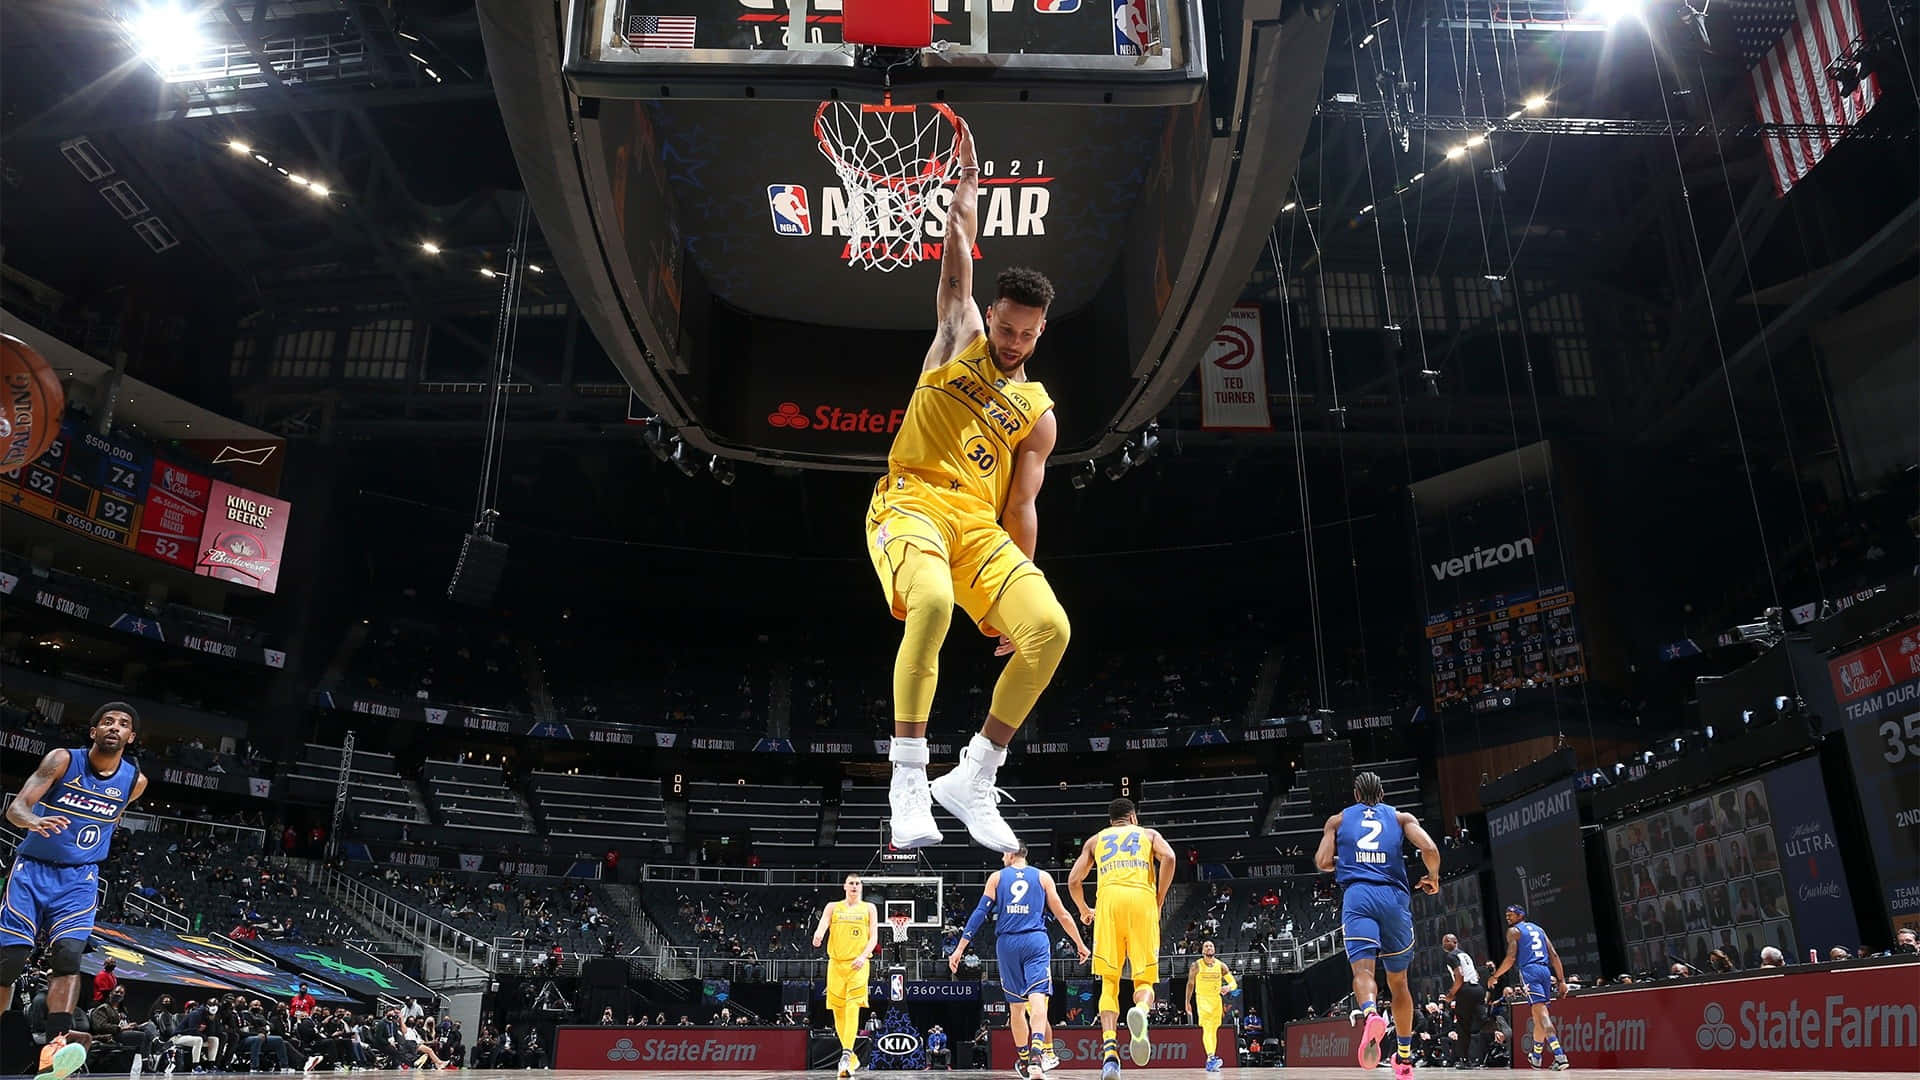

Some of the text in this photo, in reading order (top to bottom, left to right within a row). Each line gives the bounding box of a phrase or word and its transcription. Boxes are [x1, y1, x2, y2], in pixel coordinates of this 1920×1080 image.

[1120, 44, 1136, 55] NBA
[958, 160, 1044, 176] 021
[780, 223, 797, 233] NBA
[840, 243, 983, 260] ATLANA
[1224, 377, 1243, 389] TED
[1013, 394, 1028, 410] KIA
[1215, 392, 1255, 404] TURNER
[813, 405, 906, 434] StateF
[85, 434, 133, 462] $500,000
[967, 444, 994, 471] 30
[29, 470, 54, 494] 52
[112, 466, 135, 488] 74
[104, 502, 128, 523] 92
[227, 495, 273, 517] KING OF
[66, 514, 116, 540] $650,000
[228, 508, 267, 530] BEERS.
[155, 537, 179, 559] 52
[209, 549, 272, 573] Budweiser
[1432, 536, 1535, 581] verizon
[41, 593, 55, 609] ALL
[56, 598, 75, 615] STAR
[189, 636, 202, 650] ALL
[203, 639, 222, 656] STAR
[358, 702, 368, 713] ALL
[370, 703, 387, 717] STAR
[1846, 696, 1883, 720] TEAM
[469, 717, 479, 729] ALL
[481, 719, 497, 731] STAR
[1352, 718, 1363, 729] ALL
[1364, 716, 1380, 728] STAR
[9, 734, 29, 752] STAR
[595, 731, 605, 742] ALL
[606, 732, 621, 744] STAR
[1261, 729, 1275, 739] STAR
[696, 738, 706, 749] ALL
[707, 739, 722, 750] STAR
[826, 743, 841, 753] STAR
[1042, 743, 1056, 753] STAR
[1130, 740, 1140, 750] ALL
[1141, 738, 1156, 749] STAR
[170, 769, 183, 783] ALL
[184, 772, 203, 787] STAR
[1489, 790, 1572, 838] TEAM DURANT
[83, 831, 96, 843] 11
[1357, 820, 1382, 850] 2
[1101, 832, 1141, 862] 34
[1786, 833, 1834, 857] ULTRA
[409, 854, 425, 866] STAR
[1355, 851, 1386, 864] LEONARD
[518, 863, 534, 874] STAR
[1528, 873, 1551, 891] UNCF
[1010, 880, 1029, 904] 9
[1529, 931, 1542, 950] 3
[885, 1038, 911, 1050] KIA
